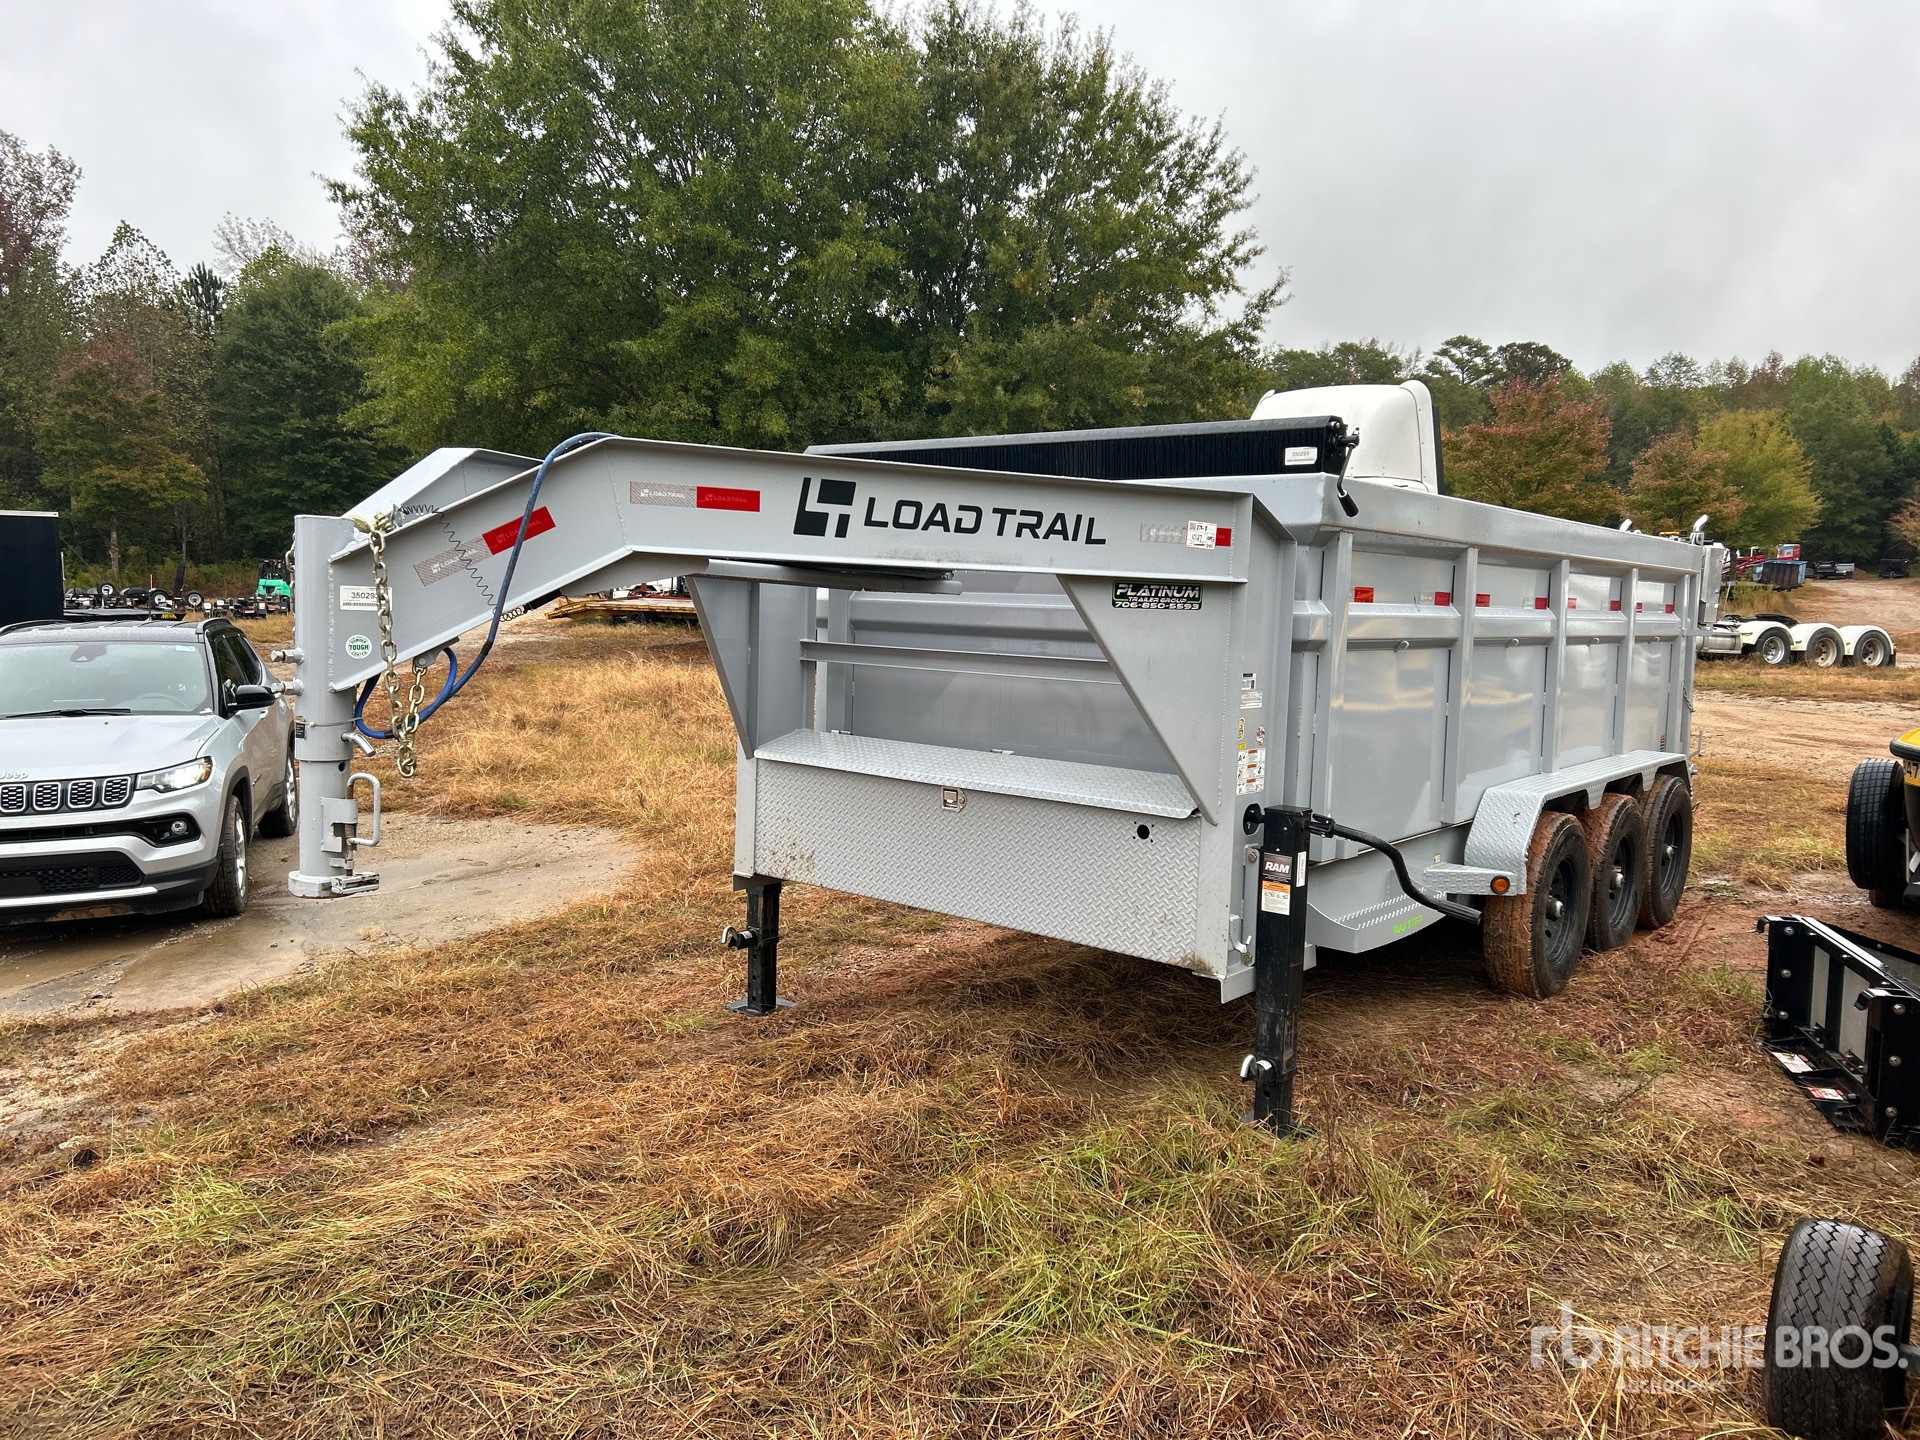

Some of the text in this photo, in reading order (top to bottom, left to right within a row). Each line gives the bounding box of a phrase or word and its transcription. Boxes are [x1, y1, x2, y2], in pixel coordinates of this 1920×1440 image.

[863, 496, 1107, 545] LOAD TRAIL
[350, 591, 376, 600] 35029
[1116, 584, 1199, 598] PLATINUM
[0, 770, 29, 780] Jeep
[1264, 860, 1291, 874] RAM
